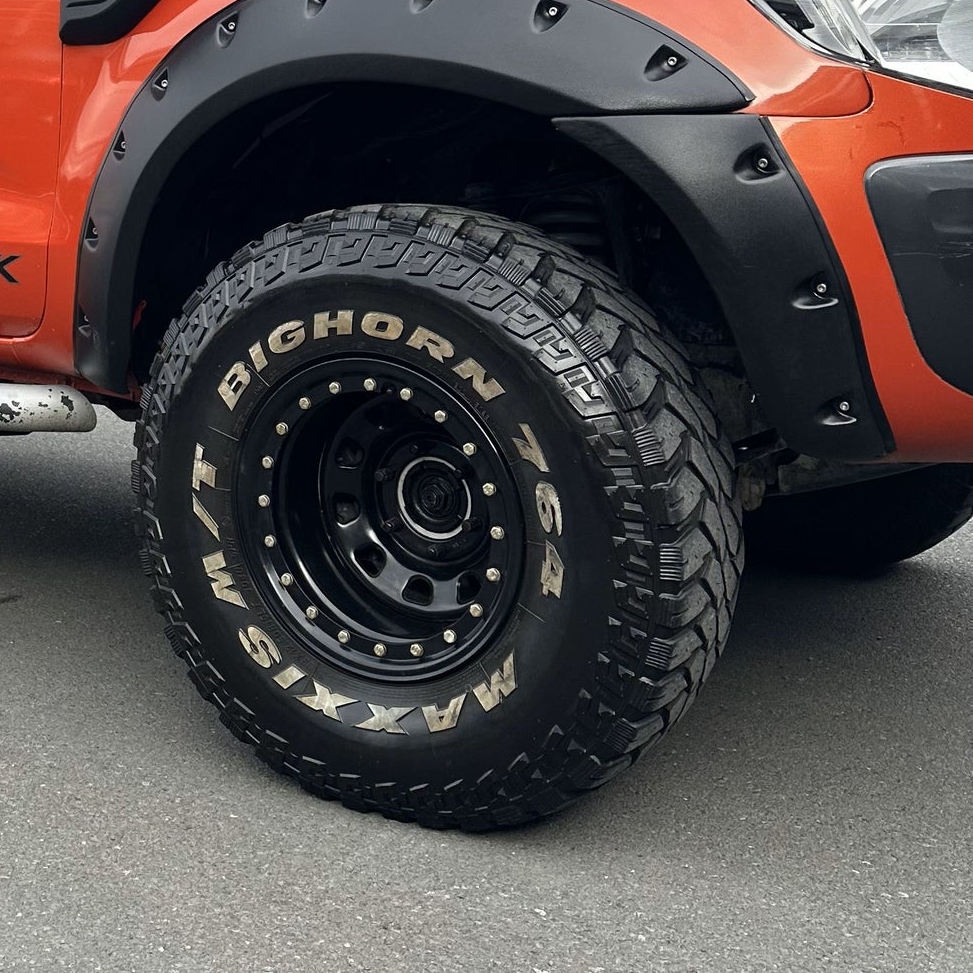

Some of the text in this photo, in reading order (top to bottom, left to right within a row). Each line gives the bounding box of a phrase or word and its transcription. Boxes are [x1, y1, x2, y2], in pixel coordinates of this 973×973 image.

[192, 310, 565, 735] MAXXIS M/T BIGHORN 764
